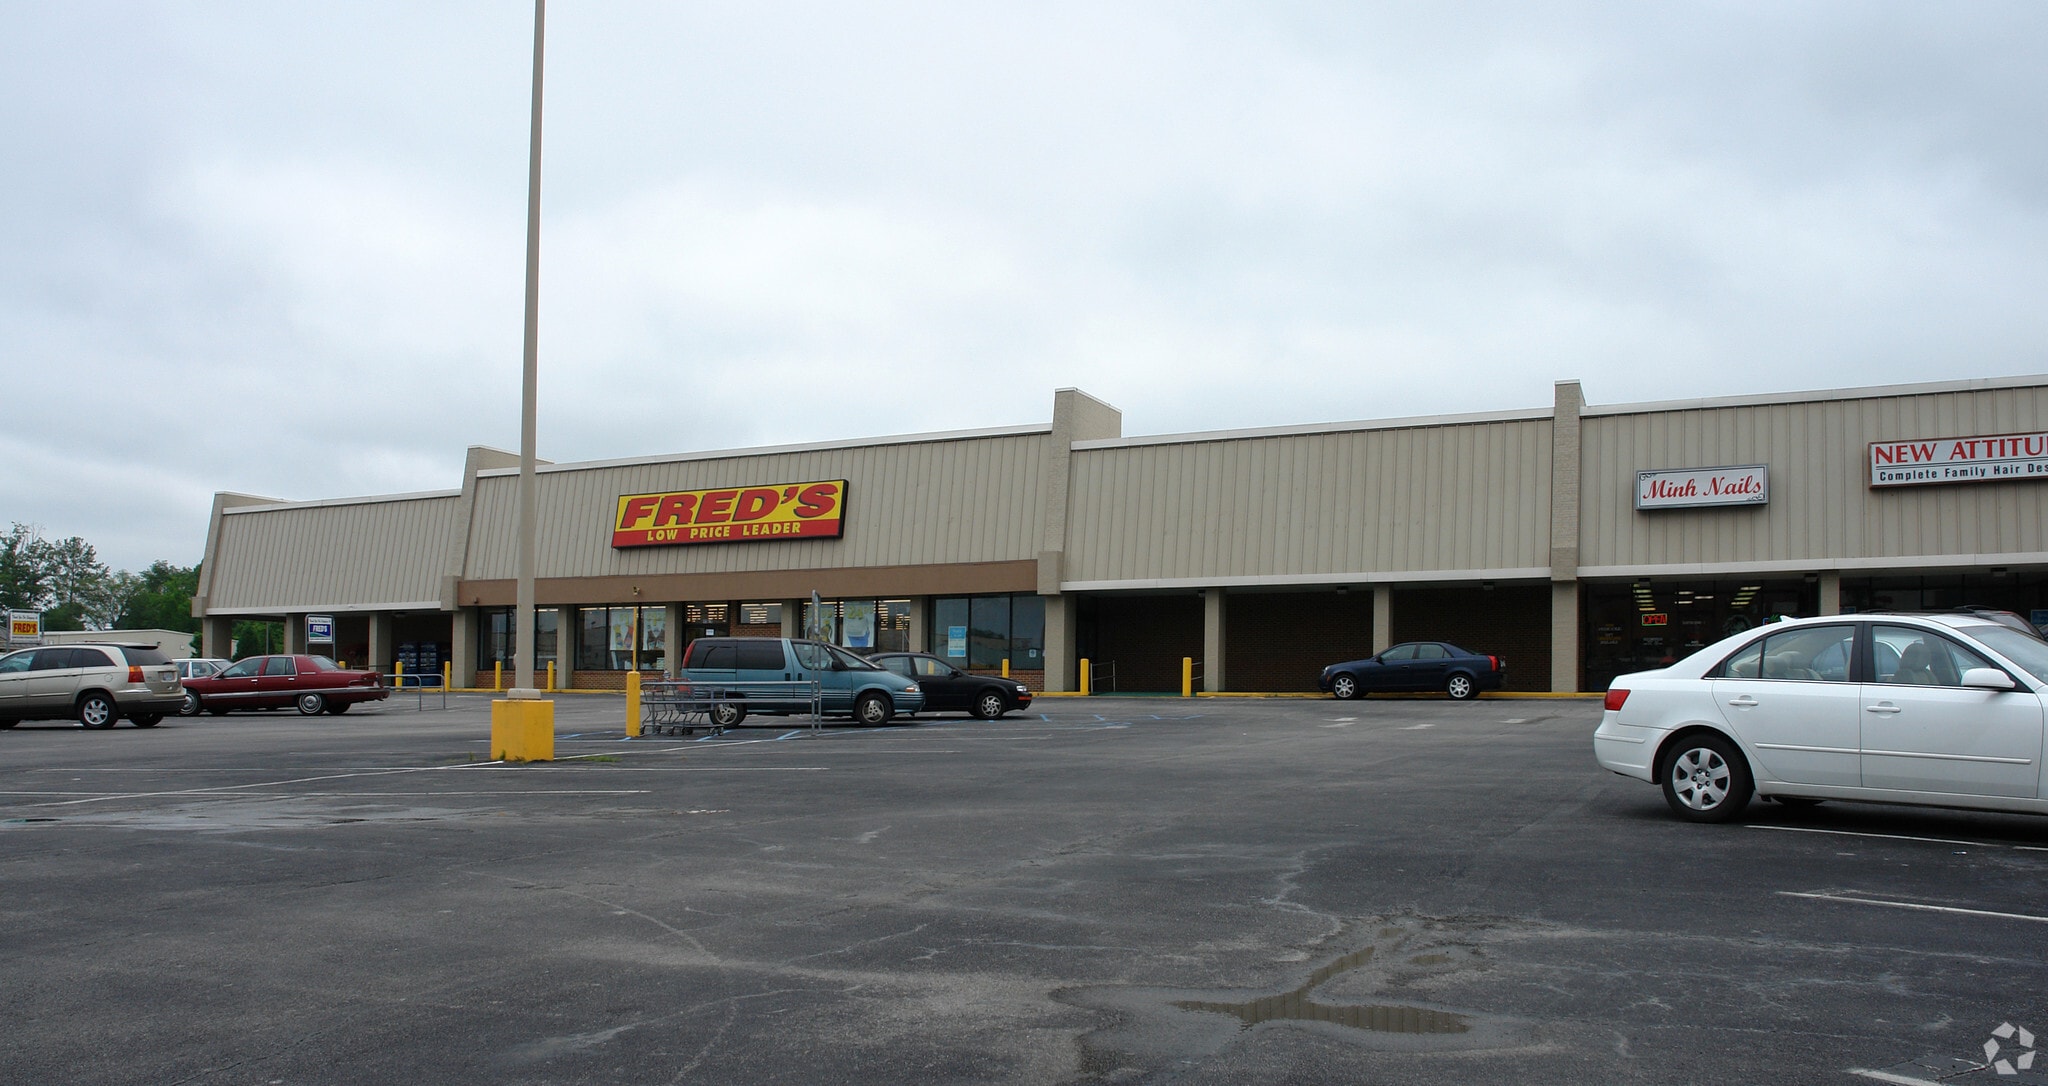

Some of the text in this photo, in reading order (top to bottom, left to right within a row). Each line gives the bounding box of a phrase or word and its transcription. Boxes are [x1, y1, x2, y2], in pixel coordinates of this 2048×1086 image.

[1875, 436, 2048, 465] NEW ATTITU
[1880, 470, 1938, 482] Complete
[1945, 467, 1986, 478] Family
[1993, 464, 2020, 475] Hair
[1643, 475, 1762, 500] Minh Nails
[619, 483, 839, 529] FRED'S
[647, 522, 801, 542] LOW PRICE LEADER
[13, 622, 37, 634] FRED'S
[1643, 614, 1667, 625] OPEN
